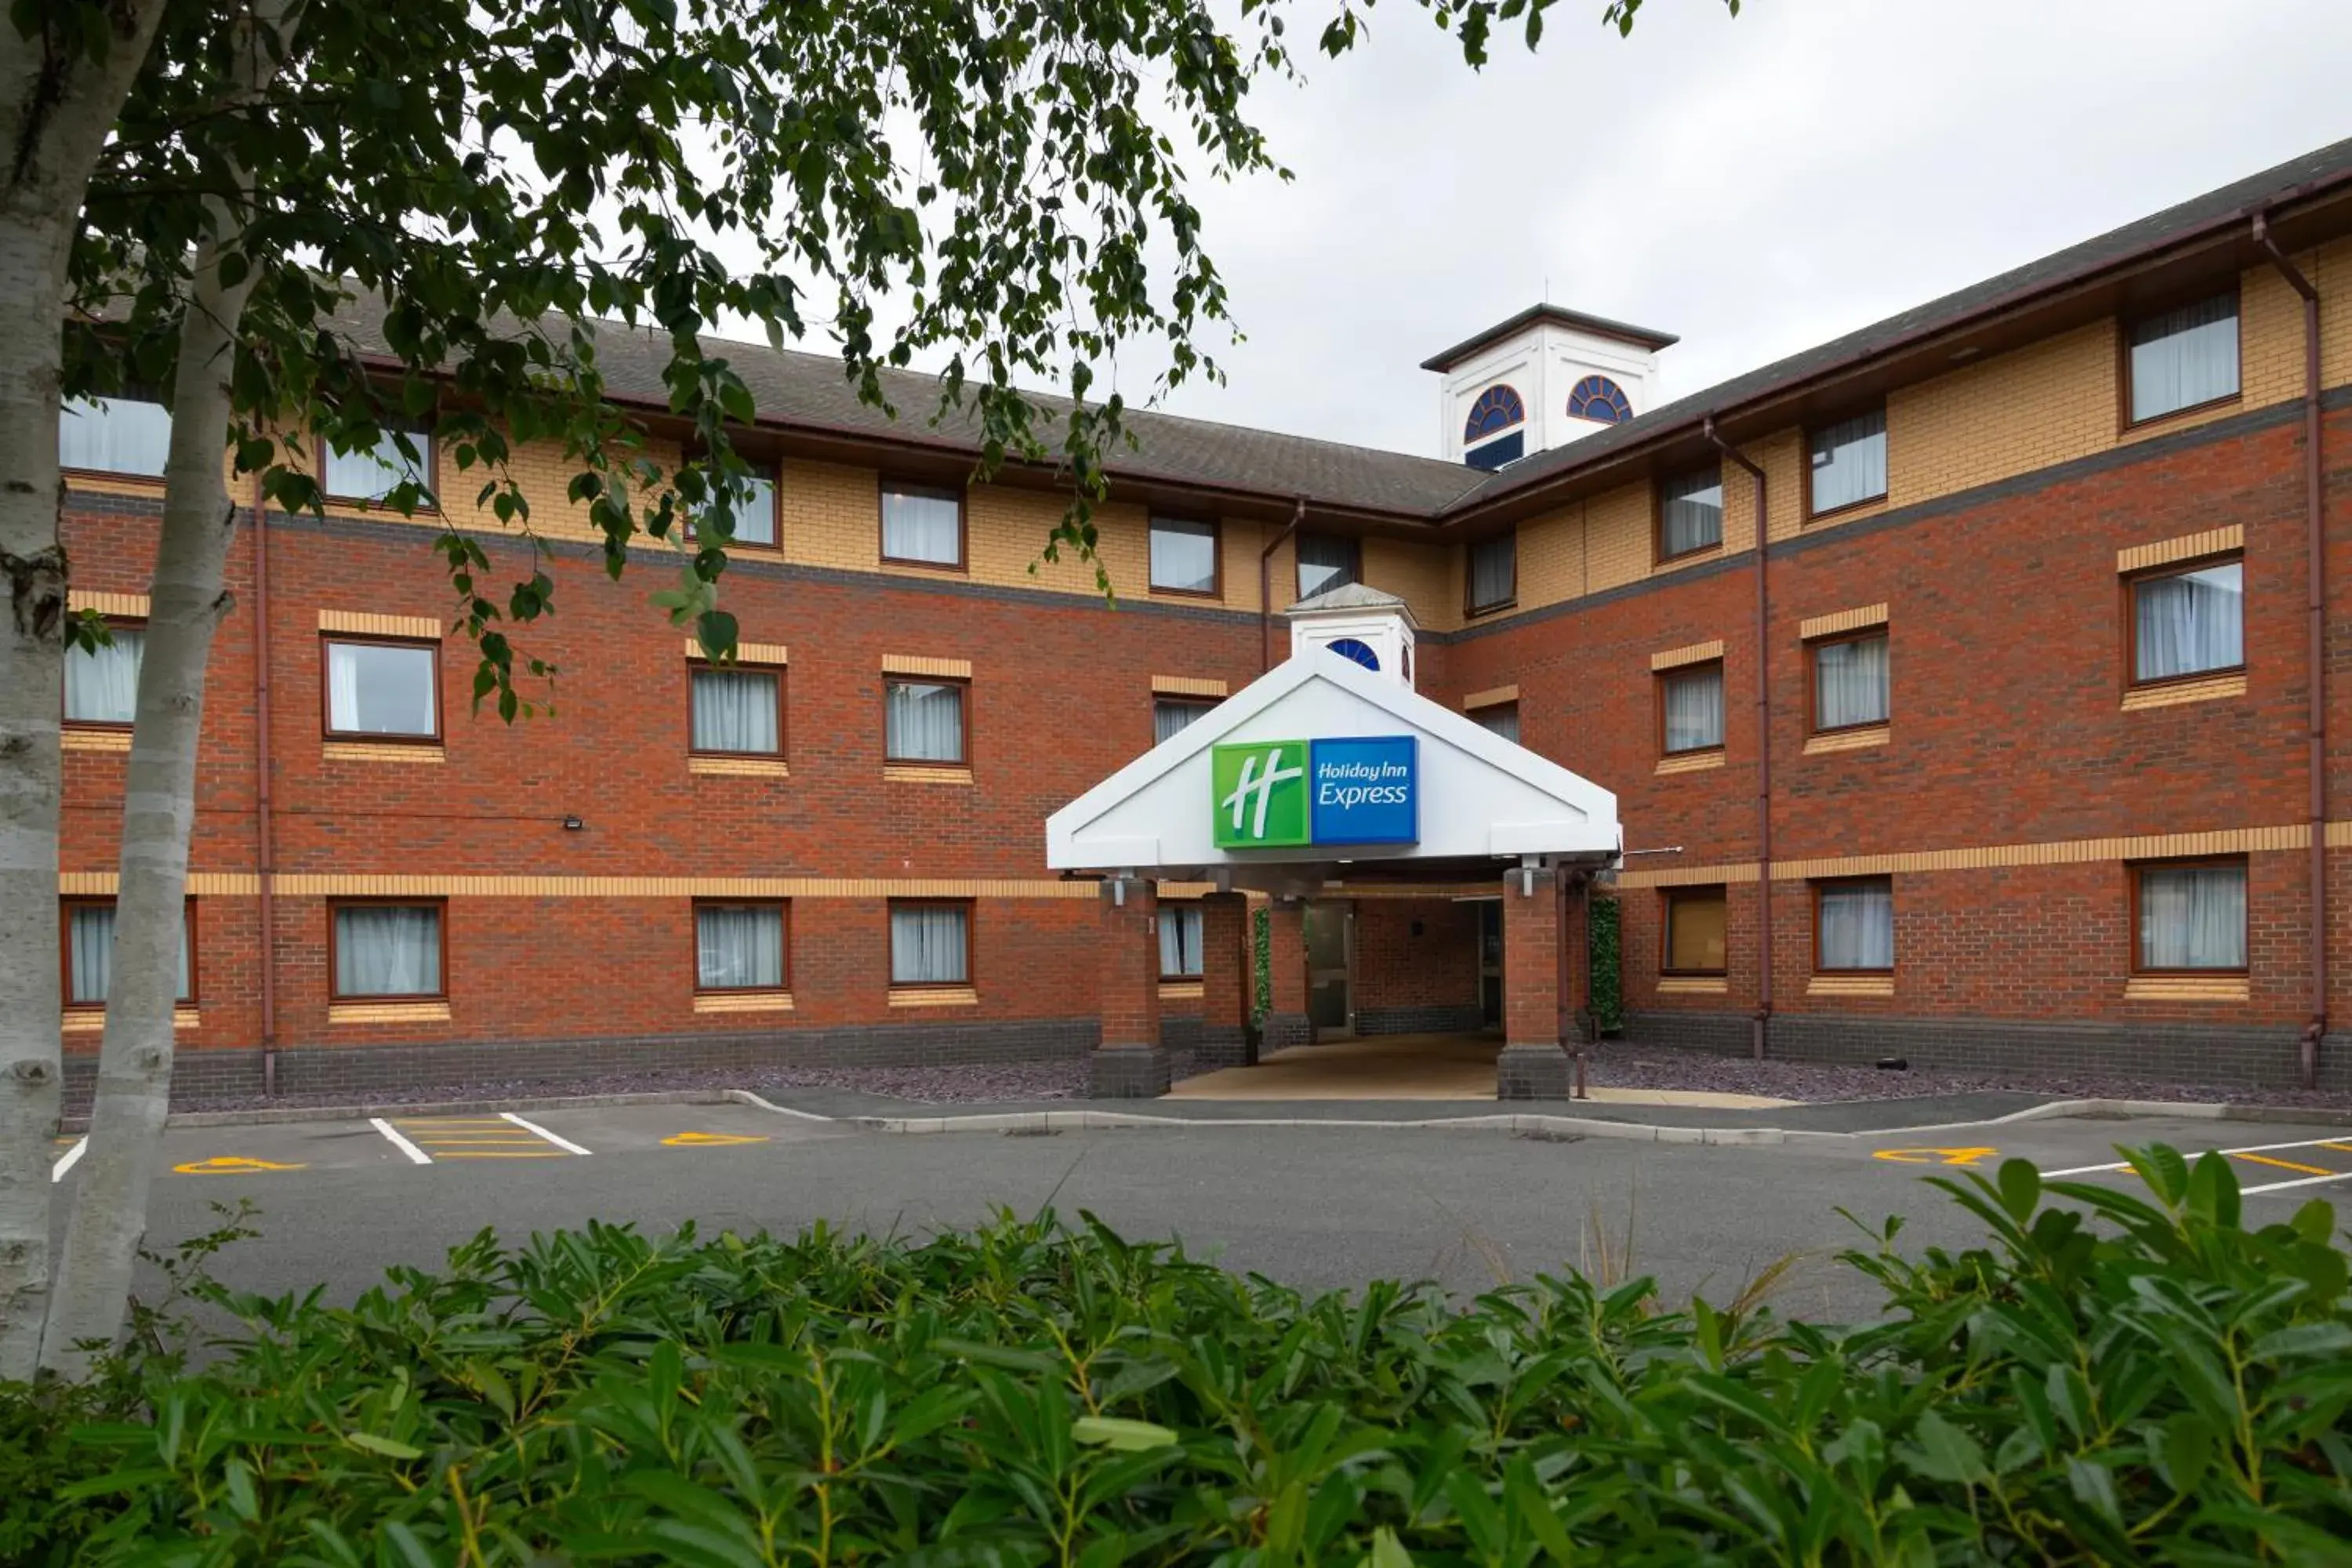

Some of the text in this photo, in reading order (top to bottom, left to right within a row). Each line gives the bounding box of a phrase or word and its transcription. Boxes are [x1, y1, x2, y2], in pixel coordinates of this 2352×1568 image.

[1318, 761, 1407, 781] Holiday Inn
[1222, 749, 1303, 838] H
[1319, 782, 1407, 810] Express
